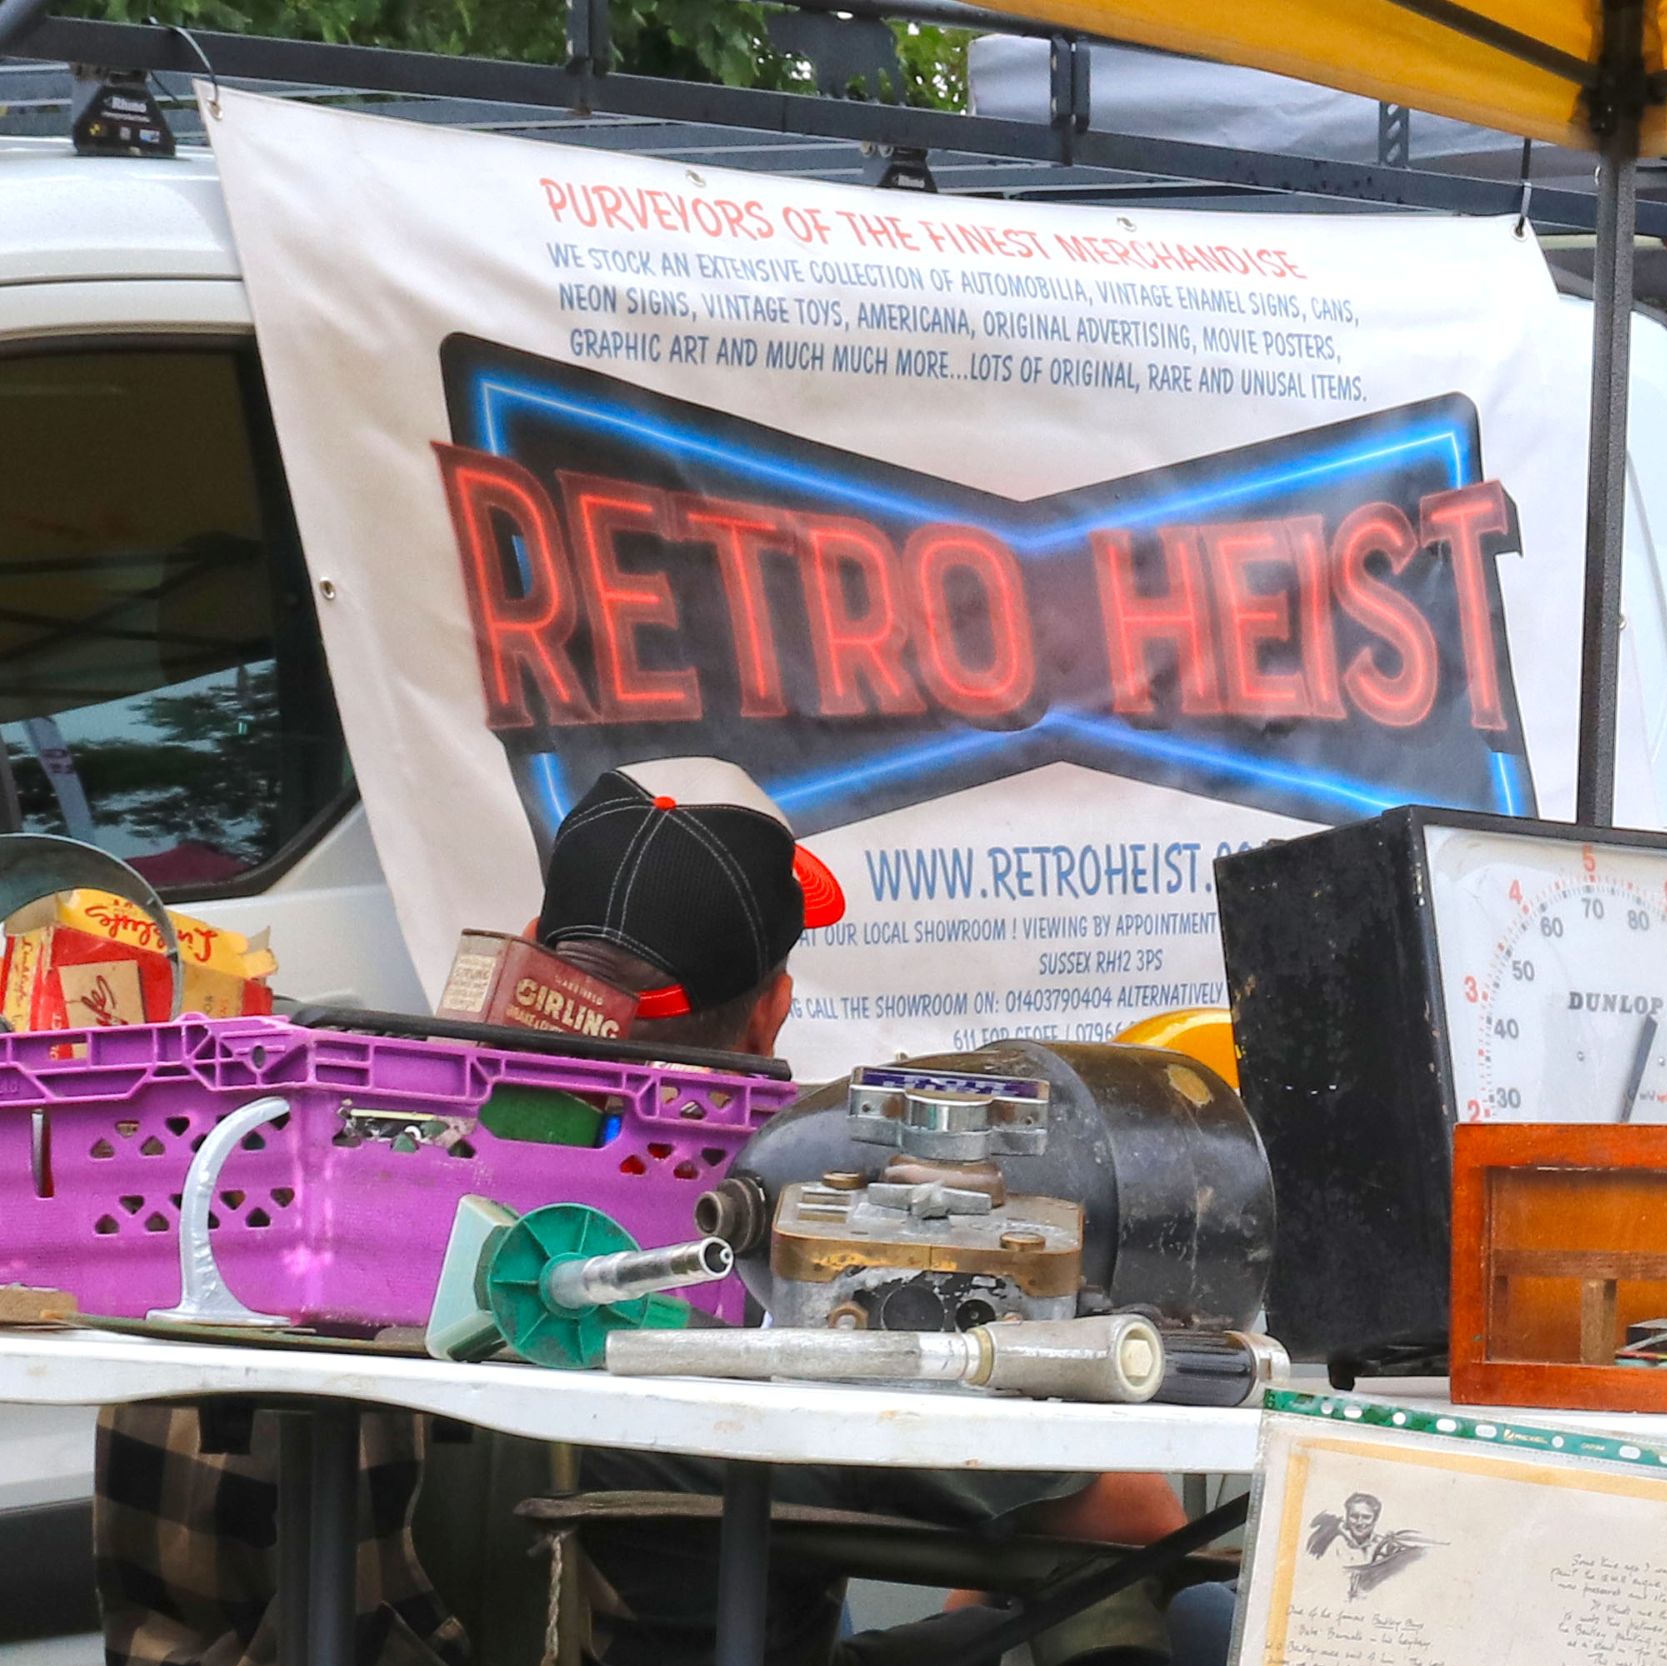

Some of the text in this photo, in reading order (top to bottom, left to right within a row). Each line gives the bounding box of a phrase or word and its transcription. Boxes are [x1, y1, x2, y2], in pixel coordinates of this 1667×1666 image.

[540, 178, 1308, 280] PURVEYORS OF THE FINEST MERCHANDISE
[547, 242, 1360, 329] WE STOCK AN EXTENSIVE COLLECTION OF AUTOMOBILIA, VINTAGE ENAMEL SIGNS, CANS,
[558, 283, 1342, 363] NEON SIGNS, VINTAGE TOYS, AMERICANA, ORIGINAL ADVERTISING, MOVIE POSTERS,
[570, 328, 661, 363] GRAPHIC
[668, 335, 709, 364] ART
[715, 339, 758, 367] AND
[765, 343, 824, 371] MUCH
[832, 345, 888, 375] MUCH
[1020, 356, 1044, 385] OF
[1050, 358, 1141, 394] ORIGINAL,
[1148, 363, 1193, 394] RARE
[1198, 367, 1234, 395] AND
[1240, 369, 1306, 399] UNUSAL
[1311, 374, 1368, 402] ITEMS.
[433, 438, 1520, 734] RETRO HEIST
[1582, 844, 1597, 873] 5
[1508, 878, 1524, 905] 4
[1581, 898, 1605, 921] 70
[1627, 909, 1651, 932] 80
[823, 923, 858, 947] OUR
[863, 921, 909, 946] LOCAL
[914, 919, 1006, 944] SHOWROOM
[1022, 916, 1088, 941] VIEWING
[1094, 914, 1113, 938] BY
[1114, 911, 1218, 937] APPOINTMENT
[1540, 915, 1564, 939] 60
[1039, 948, 1163, 976] SUSSEX RH12 3PS
[1511, 960, 1535, 982] 50
[806, 998, 841, 1022] CALL
[841, 996, 870, 1020] THE
[875, 992, 968, 1018] SHOWROOM
[974, 990, 1000, 1015] ON:
[1005, 985, 1114, 1014] 01403790404
[1117, 981, 1224, 1007] ALTERNATIVELY
[1464, 975, 1479, 1004] 3
[1568, 991, 1665, 1016] DUNLOP
[515, 977, 621, 1040] GIRLING
[953, 1028, 976, 1051] 611
[1494, 1017, 1520, 1041] 40
[1466, 1100, 1483, 1124] 2
[1496, 1087, 1522, 1110] 30
